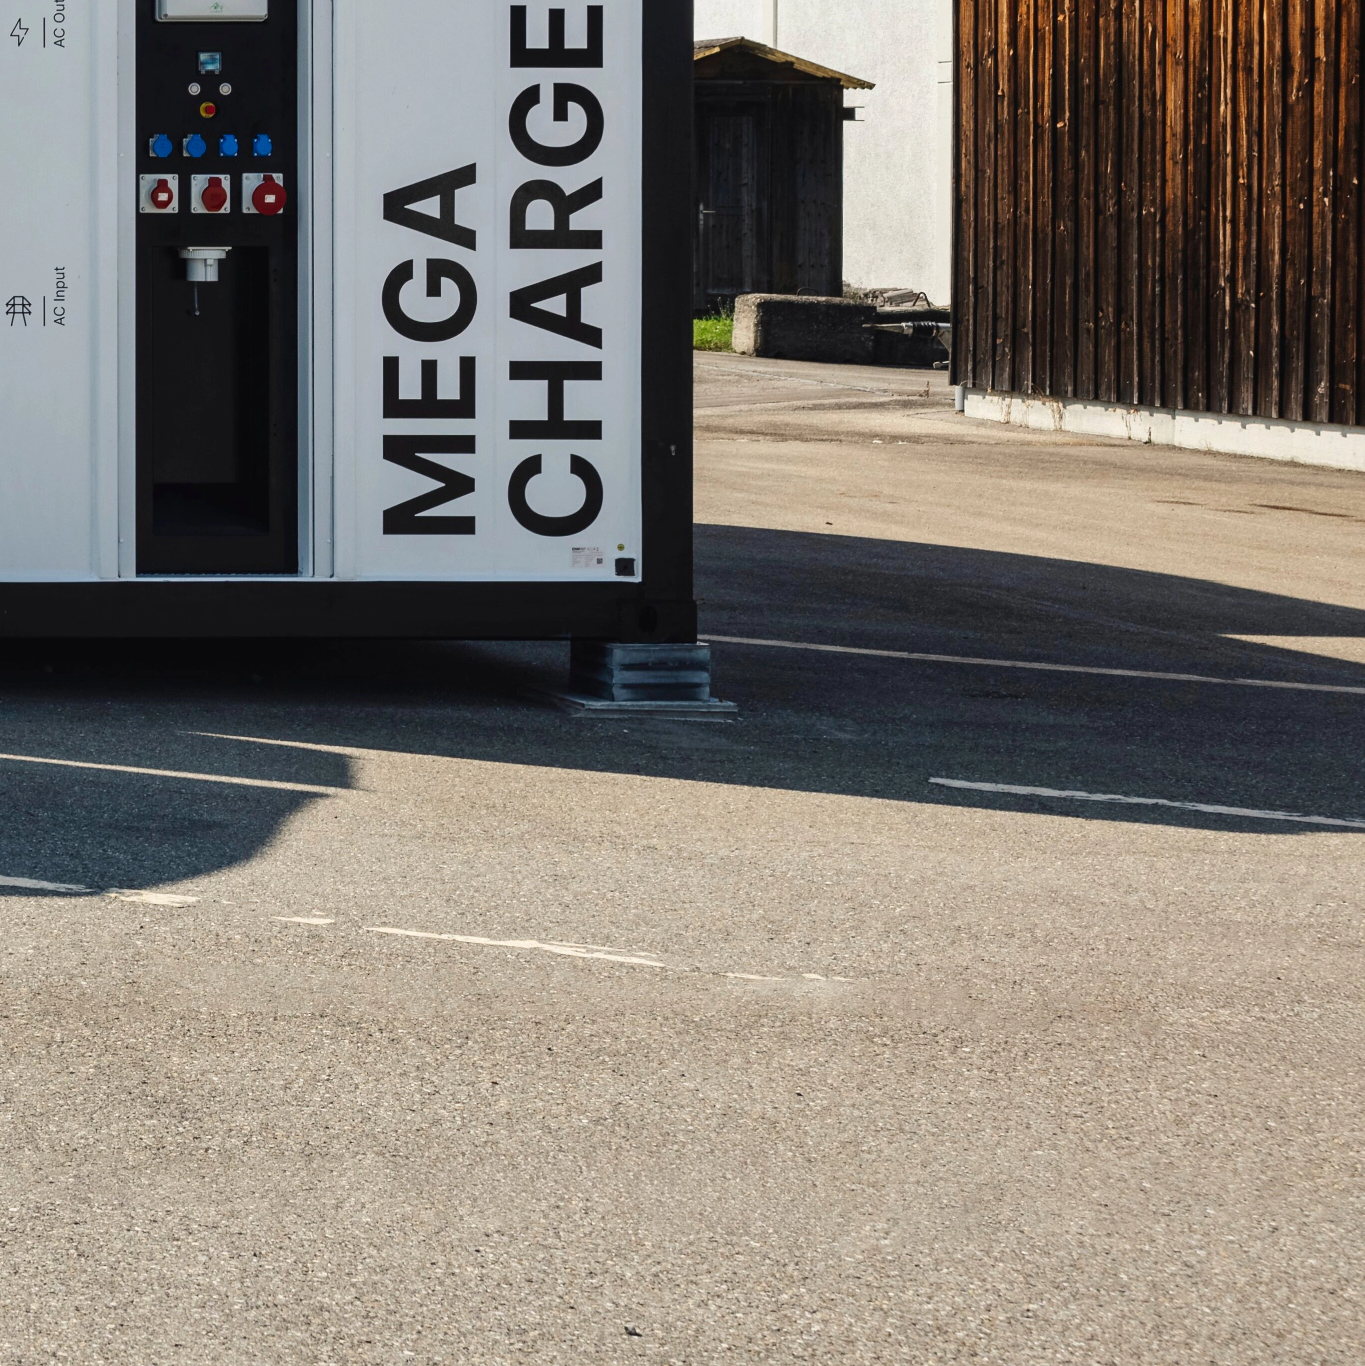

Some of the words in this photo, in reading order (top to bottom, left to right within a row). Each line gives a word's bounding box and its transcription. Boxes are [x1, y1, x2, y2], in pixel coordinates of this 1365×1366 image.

[54, 27, 66, 48] AC
[54, 266, 68, 302] Input
[54, 305, 66, 326] AC
[382, 162, 477, 535] MEGA
